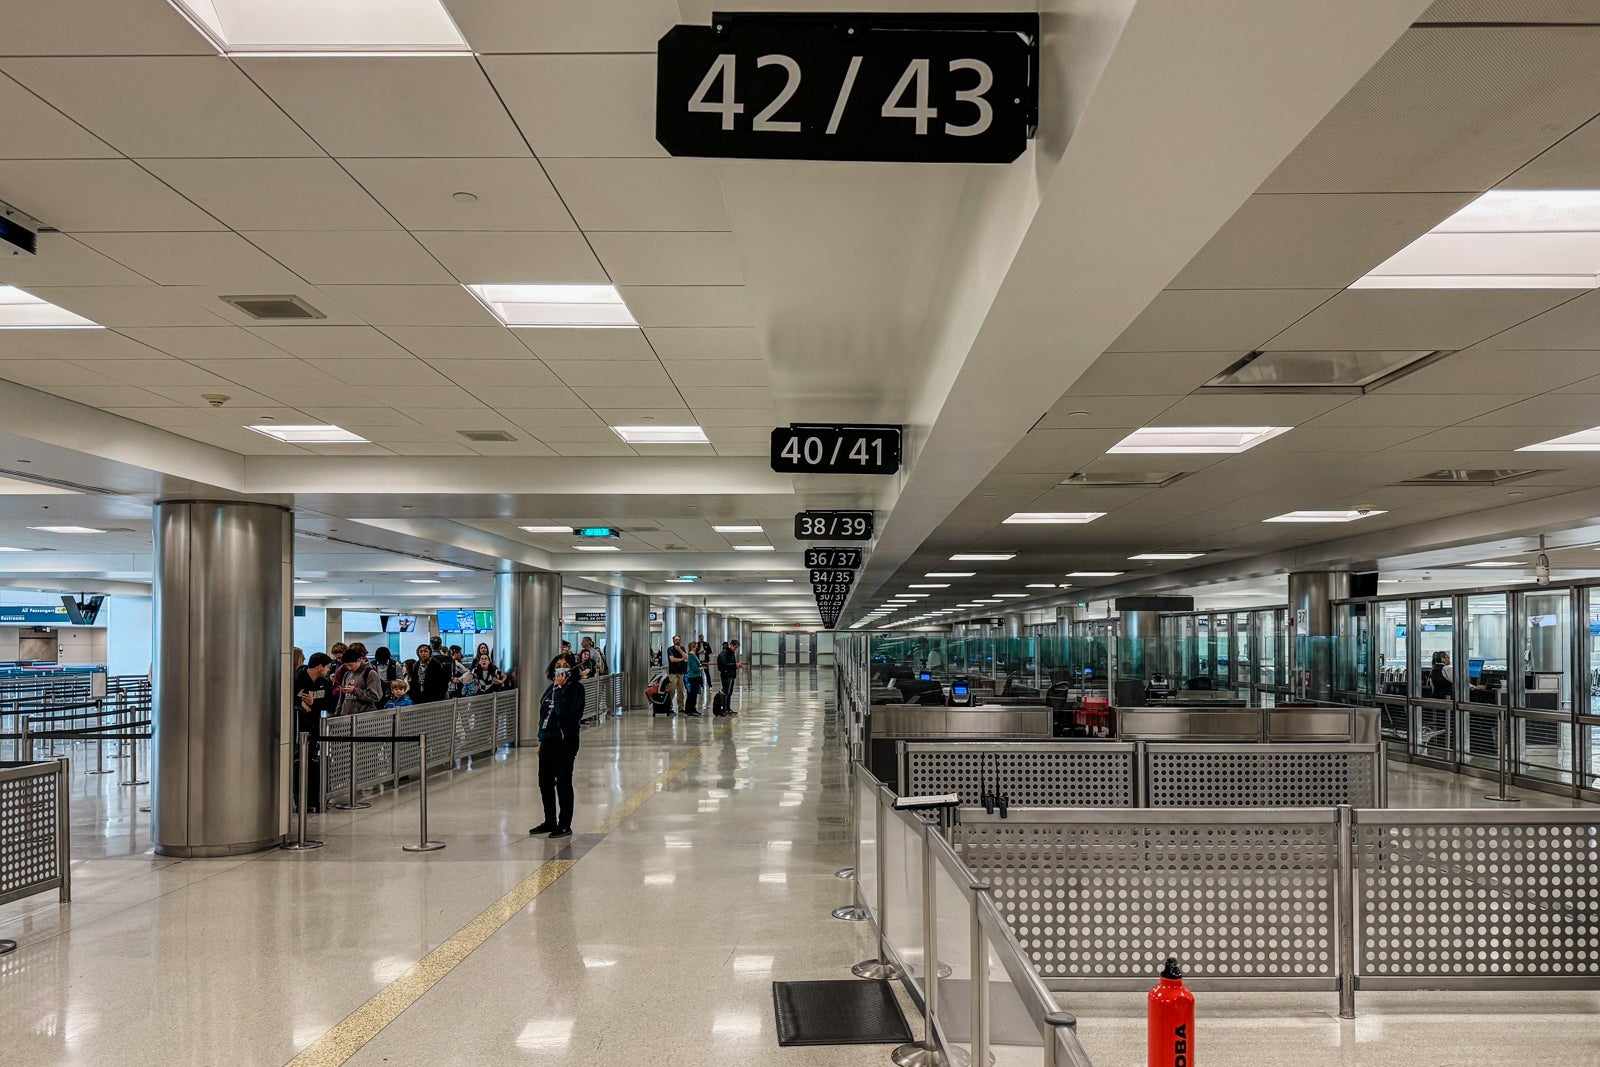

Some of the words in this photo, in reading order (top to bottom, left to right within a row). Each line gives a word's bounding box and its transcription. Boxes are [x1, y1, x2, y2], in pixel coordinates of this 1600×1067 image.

[687, 53, 802, 132] 42
[881, 58, 993, 137] 43
[780, 436, 823, 465] 40
[848, 438, 882, 466] 41
[801, 517, 826, 535] 38
[841, 518, 866, 536] 39
[808, 552, 827, 566] 36
[838, 552, 856, 566] 37
